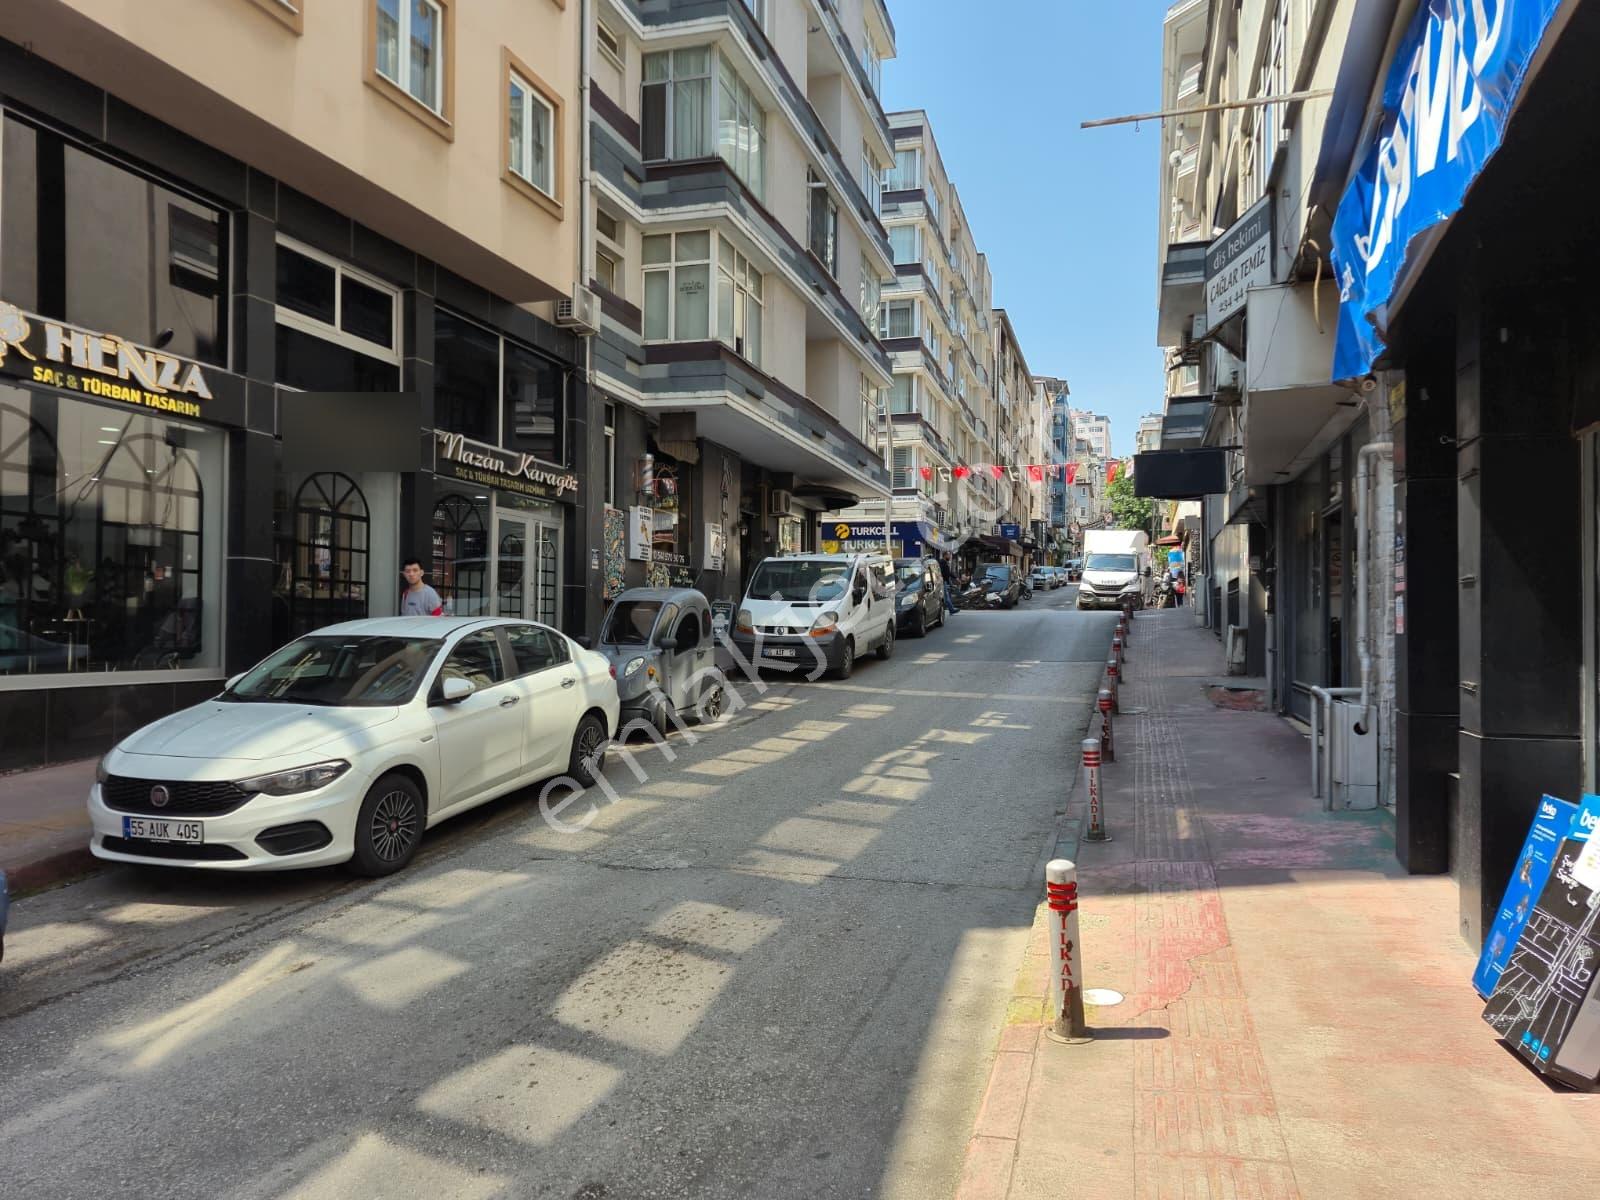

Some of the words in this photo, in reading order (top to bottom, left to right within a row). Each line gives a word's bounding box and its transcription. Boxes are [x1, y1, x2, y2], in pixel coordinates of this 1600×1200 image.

[1213, 253, 1226, 270] diş
[1228, 216, 1262, 255] hekimi
[1240, 245, 1266, 277] TEMİZ
[45, 323, 213, 400] HENZA
[33, 366, 64, 387] SAÇ
[66, 374, 79, 389] &
[81, 378, 142, 403] TÜRBAN
[143, 392, 200, 417] TASARIM
[440, 433, 505, 474] Nazan
[504, 453, 579, 497] Karagöz
[131, 820, 144, 836] 55
[150, 822, 170, 838] AUK
[176, 823, 199, 840] 405
[1579, 808, 1600, 830] be
